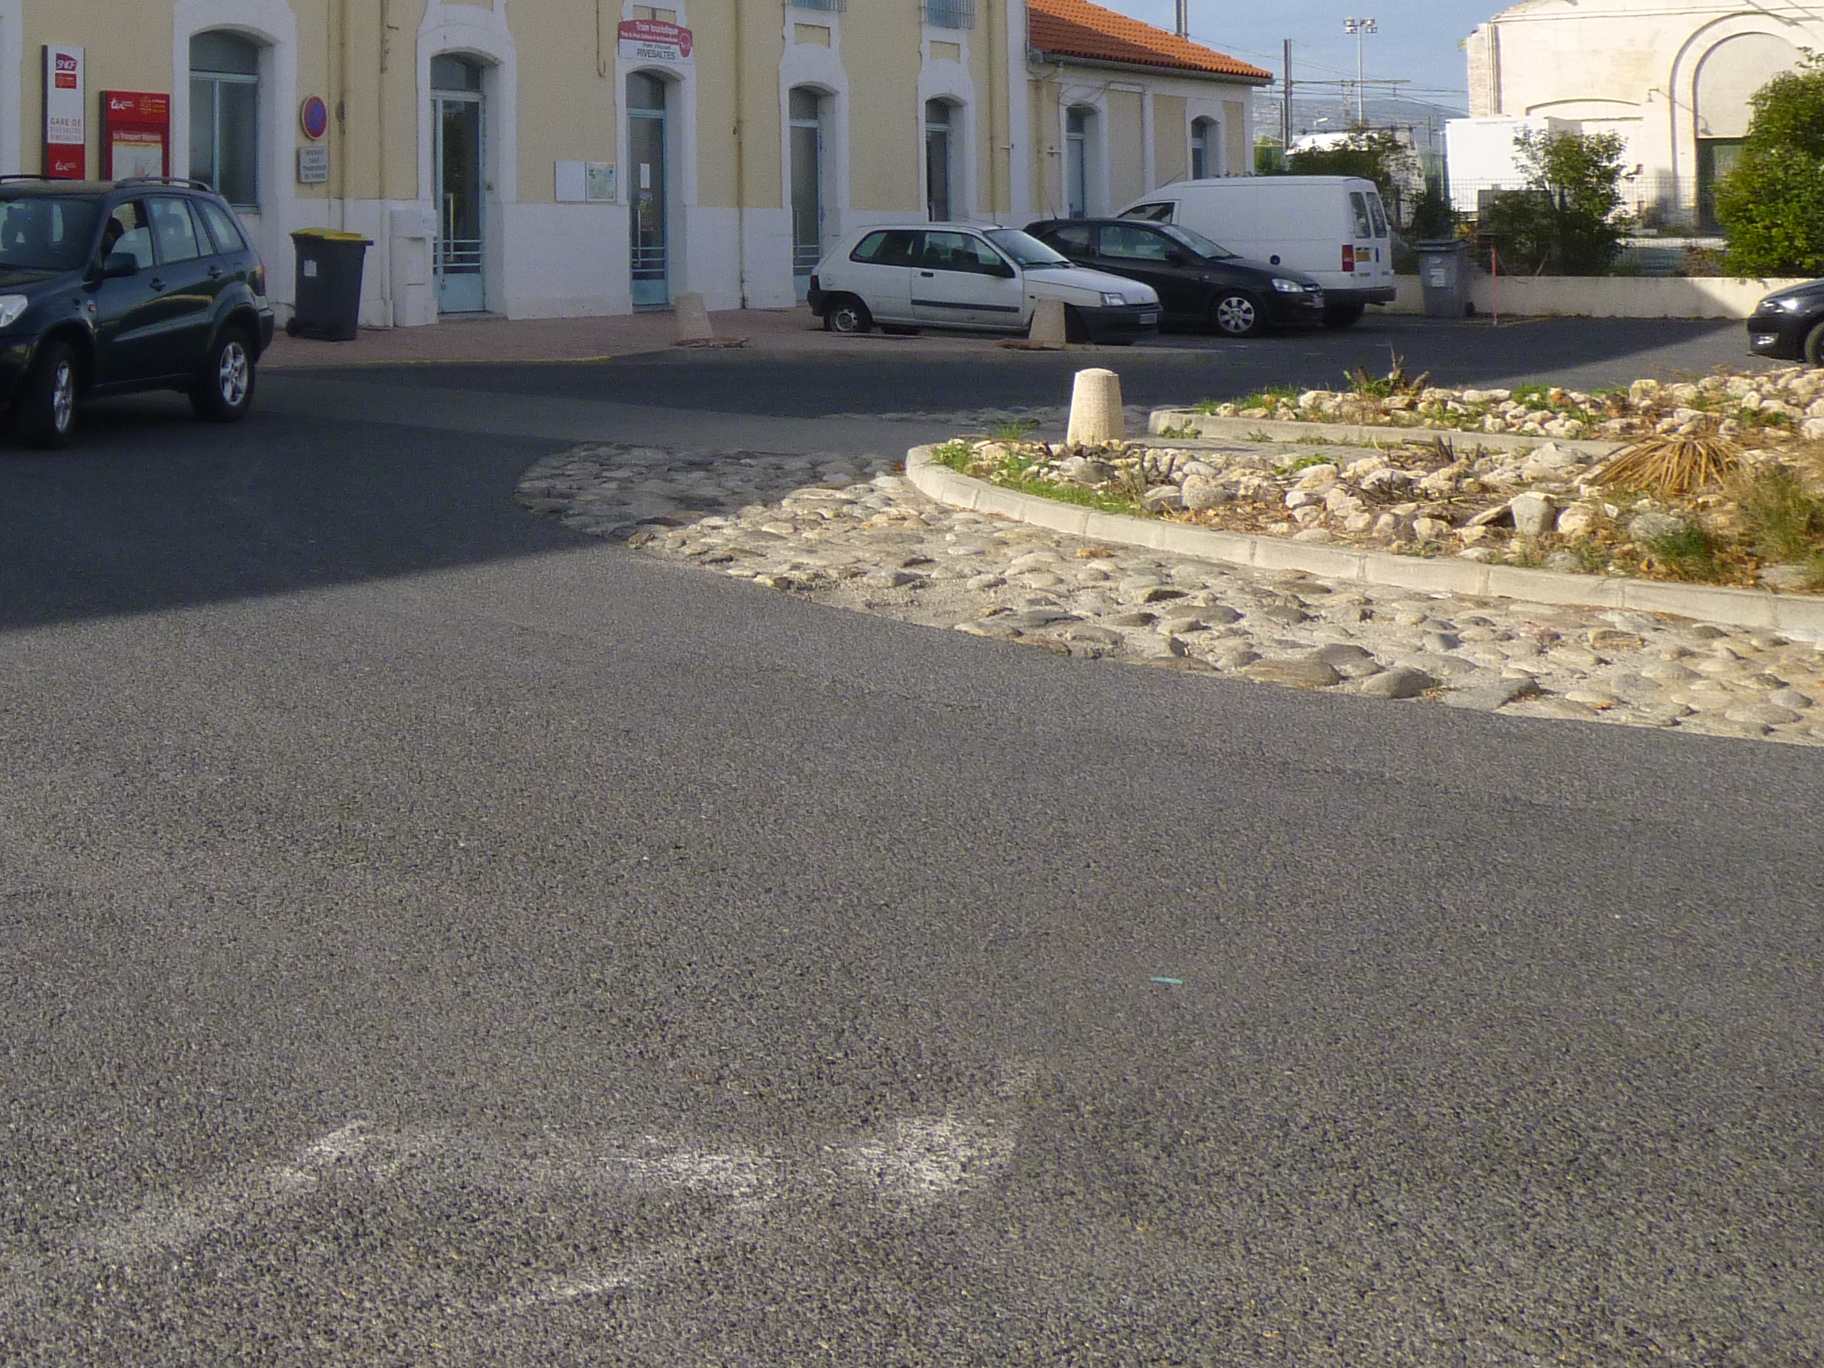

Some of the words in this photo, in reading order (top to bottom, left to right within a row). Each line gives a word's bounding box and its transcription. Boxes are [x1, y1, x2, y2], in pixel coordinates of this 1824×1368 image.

[636, 48, 676, 60] RIVESALTES
[57, 60, 77, 70] SNCF
[50, 117, 69, 127] GARE
[72, 118, 82, 127] DE
